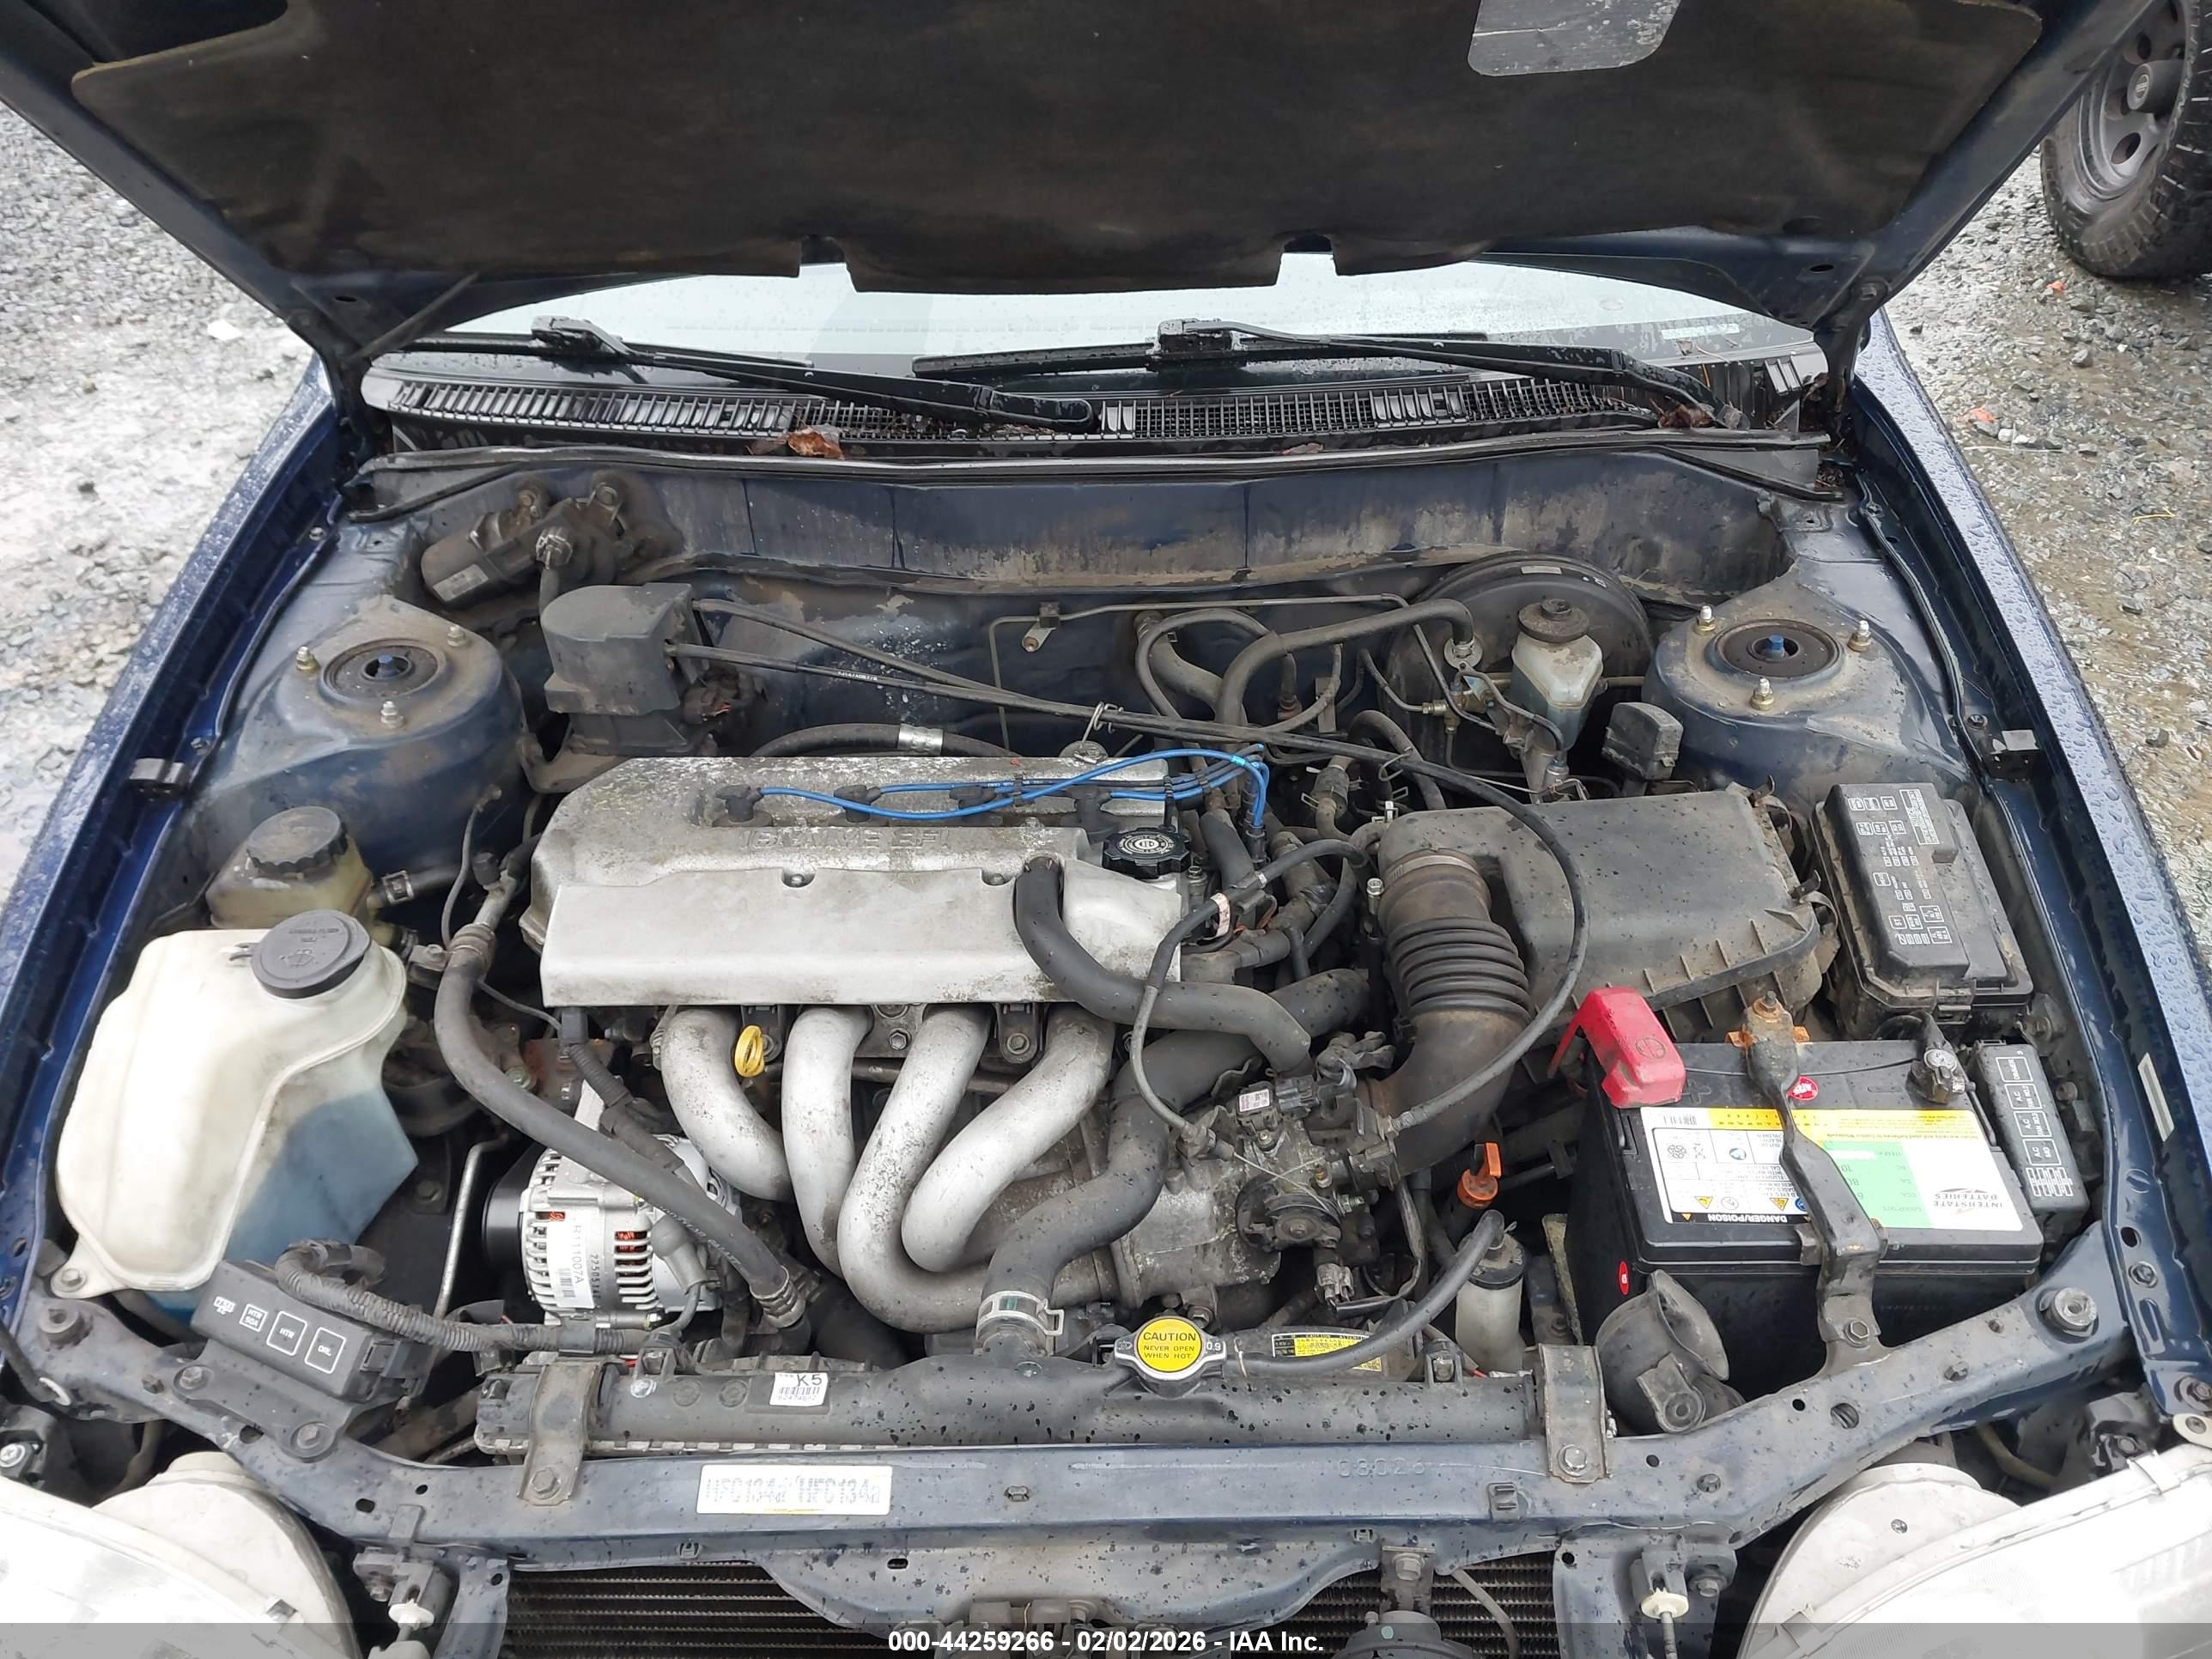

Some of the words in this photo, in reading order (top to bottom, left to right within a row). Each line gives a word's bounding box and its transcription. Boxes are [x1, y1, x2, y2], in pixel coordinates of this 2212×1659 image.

[1707, 1213, 1788, 1223] DANGER/POISON
[279, 1327, 295, 1340] HTR
[1143, 1332, 1196, 1341] CAUTION
[1206, 1341, 1222, 1352] 0.9
